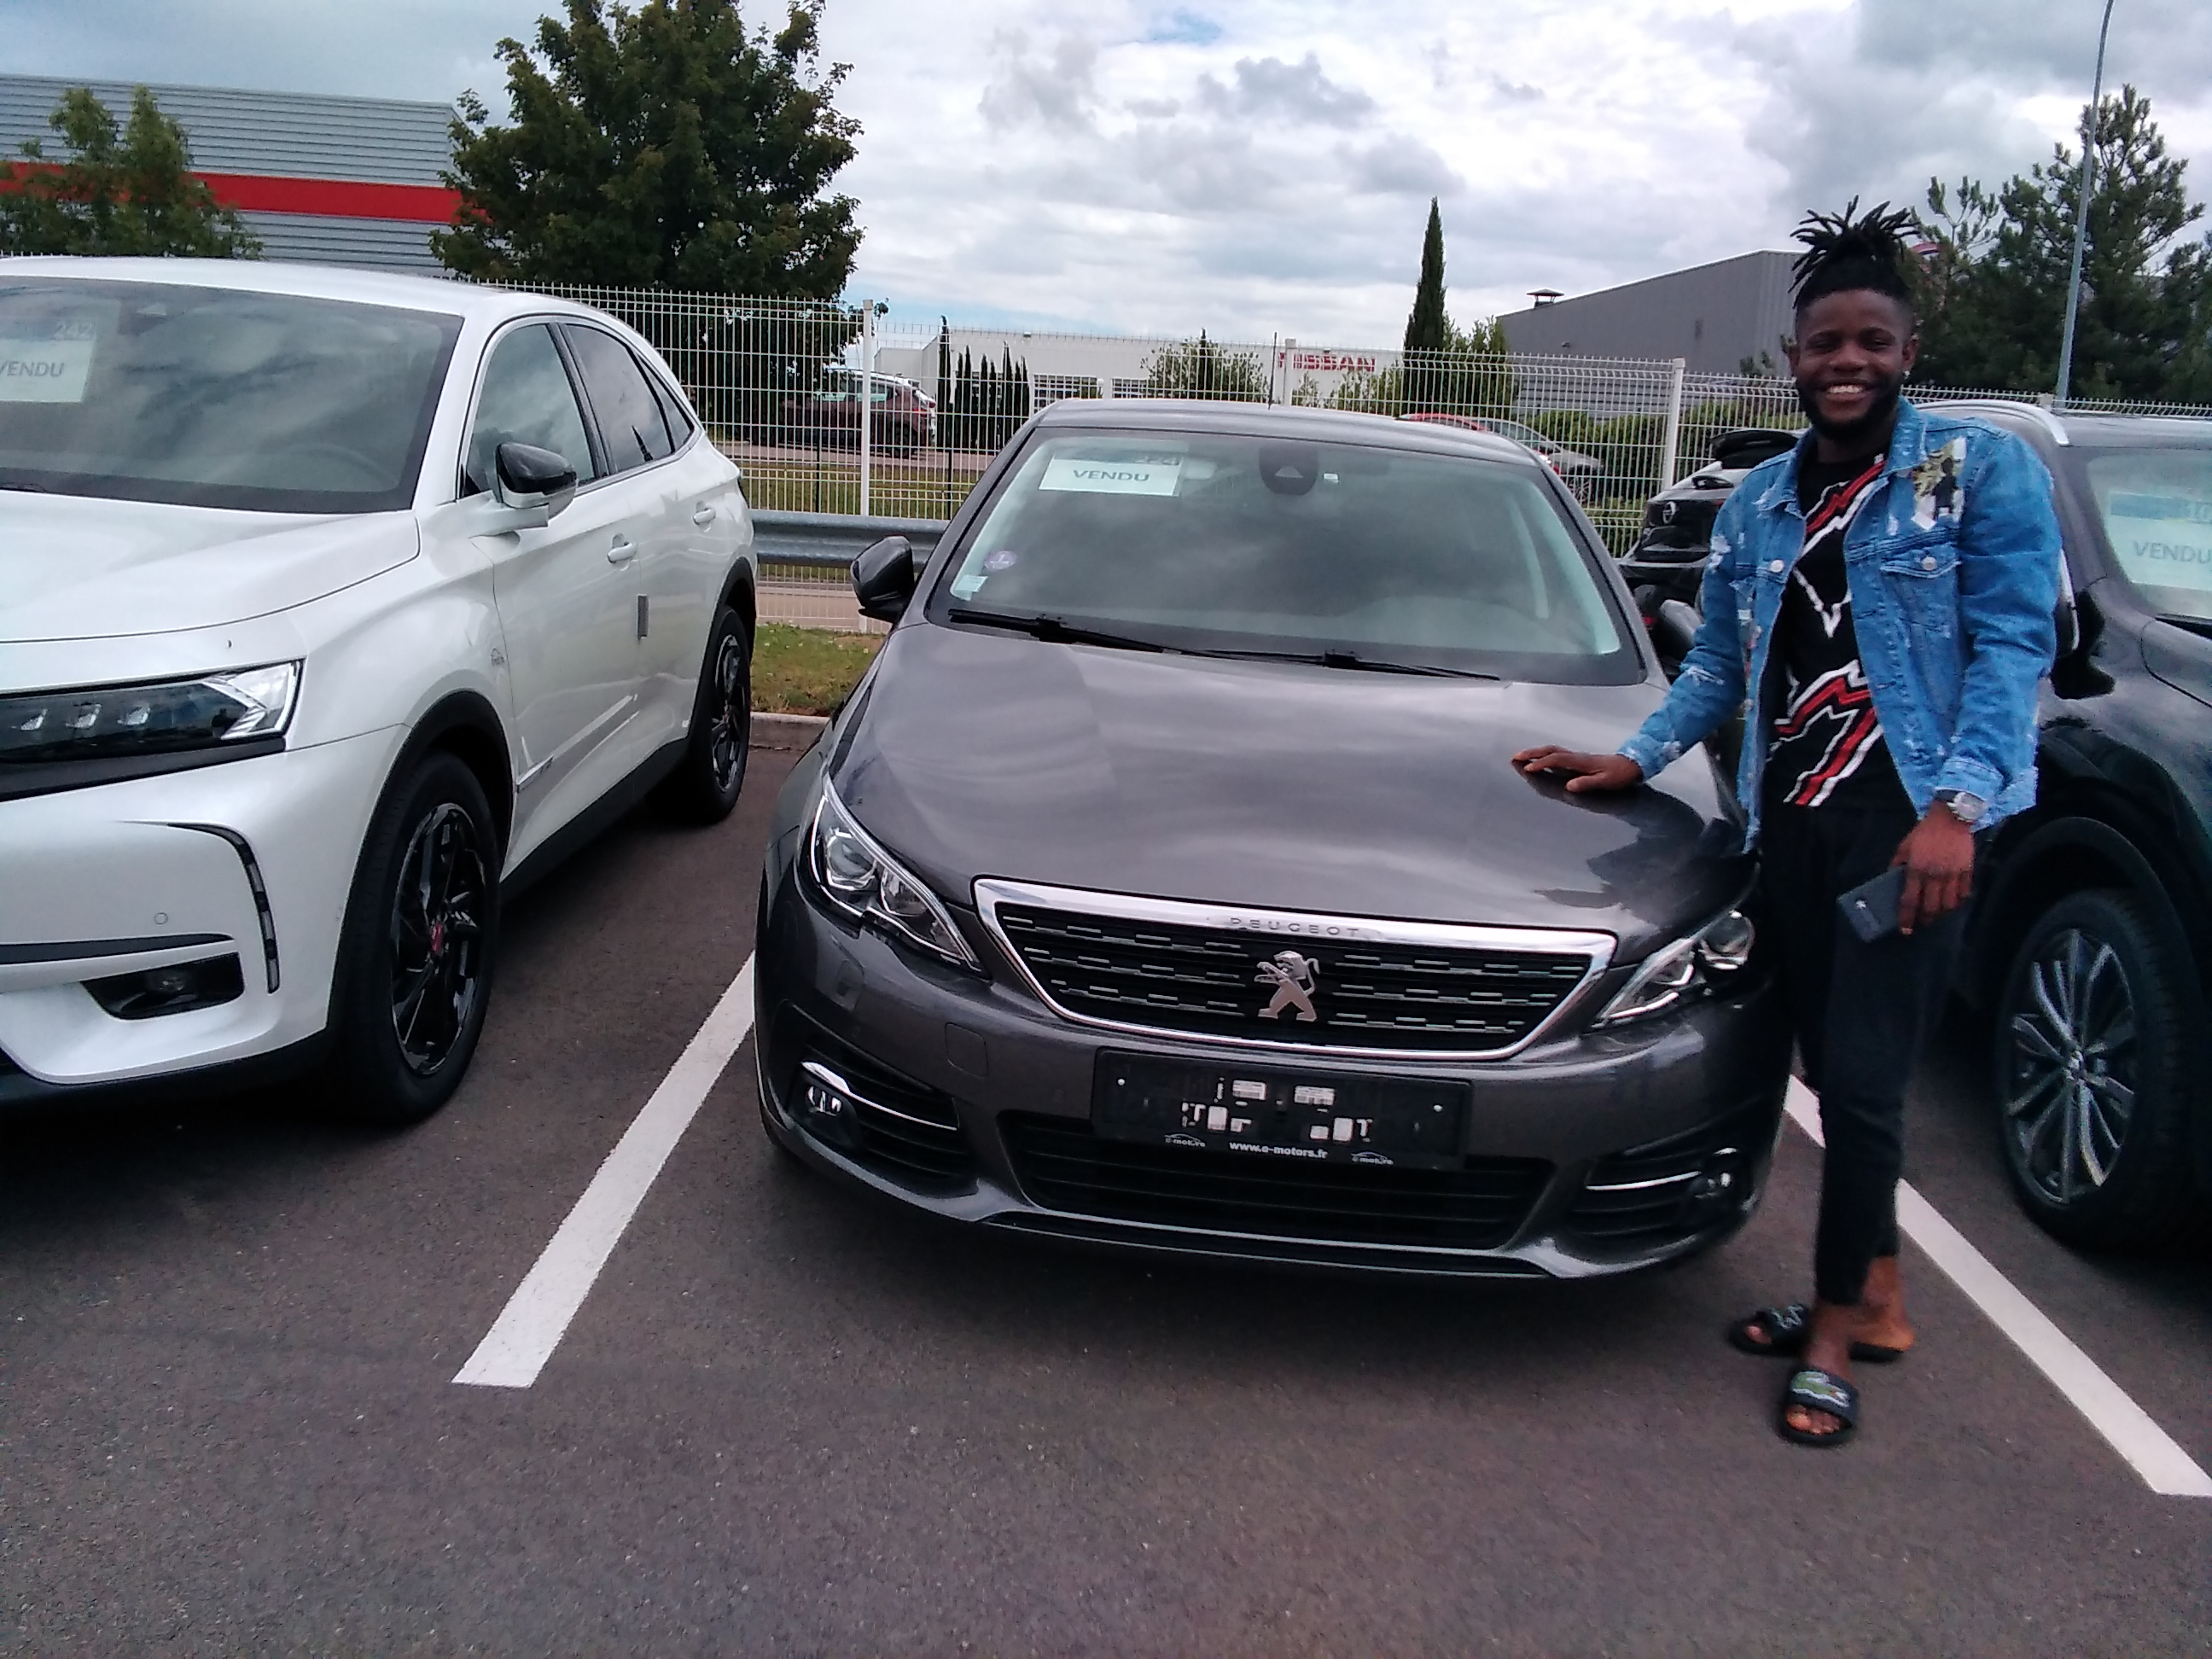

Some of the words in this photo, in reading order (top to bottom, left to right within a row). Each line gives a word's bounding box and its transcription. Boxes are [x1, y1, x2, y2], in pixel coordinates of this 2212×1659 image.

[1278, 352, 1376, 372] NISSAN
[1073, 469, 1150, 482] VENDU
[2133, 540, 2211, 564] VENDU
[1229, 917, 1359, 937] PEUGEOT
[1228, 1141, 1329, 1159] www.e-motors.fr
